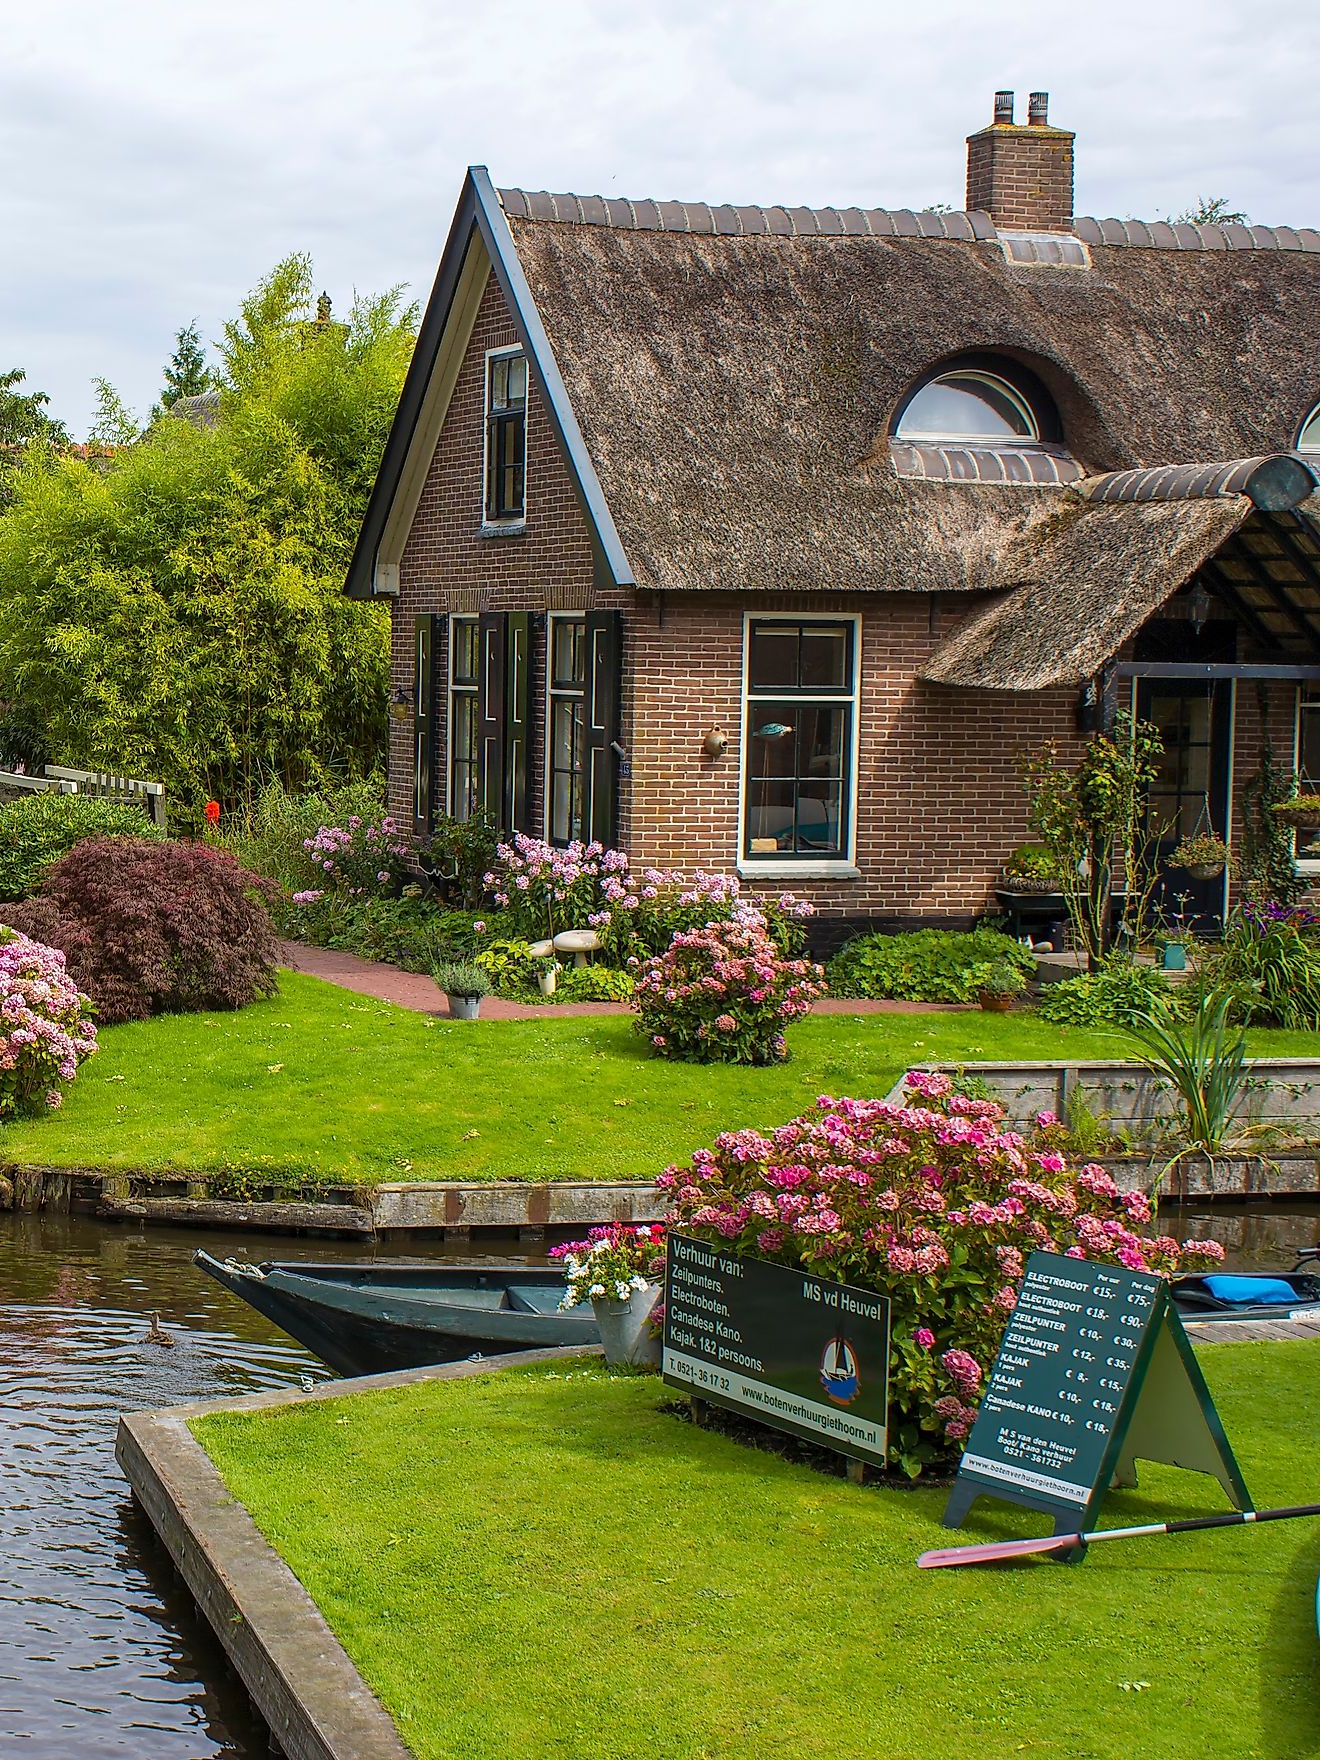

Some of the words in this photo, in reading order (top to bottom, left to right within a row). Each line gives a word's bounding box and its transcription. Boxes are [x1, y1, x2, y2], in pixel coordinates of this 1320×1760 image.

[673, 1240, 717, 1270] Verhuur
[719, 1257, 744, 1277] van:
[672, 1265, 724, 1293] Zeilpunters.
[1027, 1272, 1089, 1292] ELECTROBOOT
[672, 1285, 730, 1317] Electroboten.
[804, 1282, 820, 1301] MS
[824, 1289, 837, 1306] vd
[841, 1295, 881, 1320] Heuvel
[1021, 1292, 1082, 1313] ELECTROBOOT
[671, 1306, 713, 1333] Canadese
[716, 1320, 742, 1343] Kano.
[1014, 1313, 1066, 1331] ZEILPUNTER
[670, 1326, 696, 1348] Kajak.
[700, 1337, 716, 1354] 1&2
[718, 1346, 764, 1372] persoons.
[1007, 1333, 1060, 1352] ZEILPUNTER
[1000, 1353, 1029, 1367] KAJAK
[670, 1358, 675, 1370] T.
[698, 1370, 708, 1383] 36
[710, 1375, 718, 1386] 17
[720, 1377, 729, 1390] 32
[993, 1374, 1023, 1388] KAJAK
[742, 1386, 876, 1444] www.botenverhuurgiethoorn.nl
[987, 1394, 1026, 1411] Canadese
[1027, 1406, 1052, 1418] KANO
[1017, 1433, 1032, 1443] van
[1034, 1437, 1047, 1447] den
[1049, 1441, 1077, 1455] Heuvel
[1020, 1441, 1040, 1454] Kano
[1042, 1449, 1073, 1463] verhuur
[1004, 1447, 1023, 1458] 0521
[1031, 1455, 1062, 1469] 361732
[969, 1459, 1085, 1497] www.botenverhuurgiethoorn.nl
